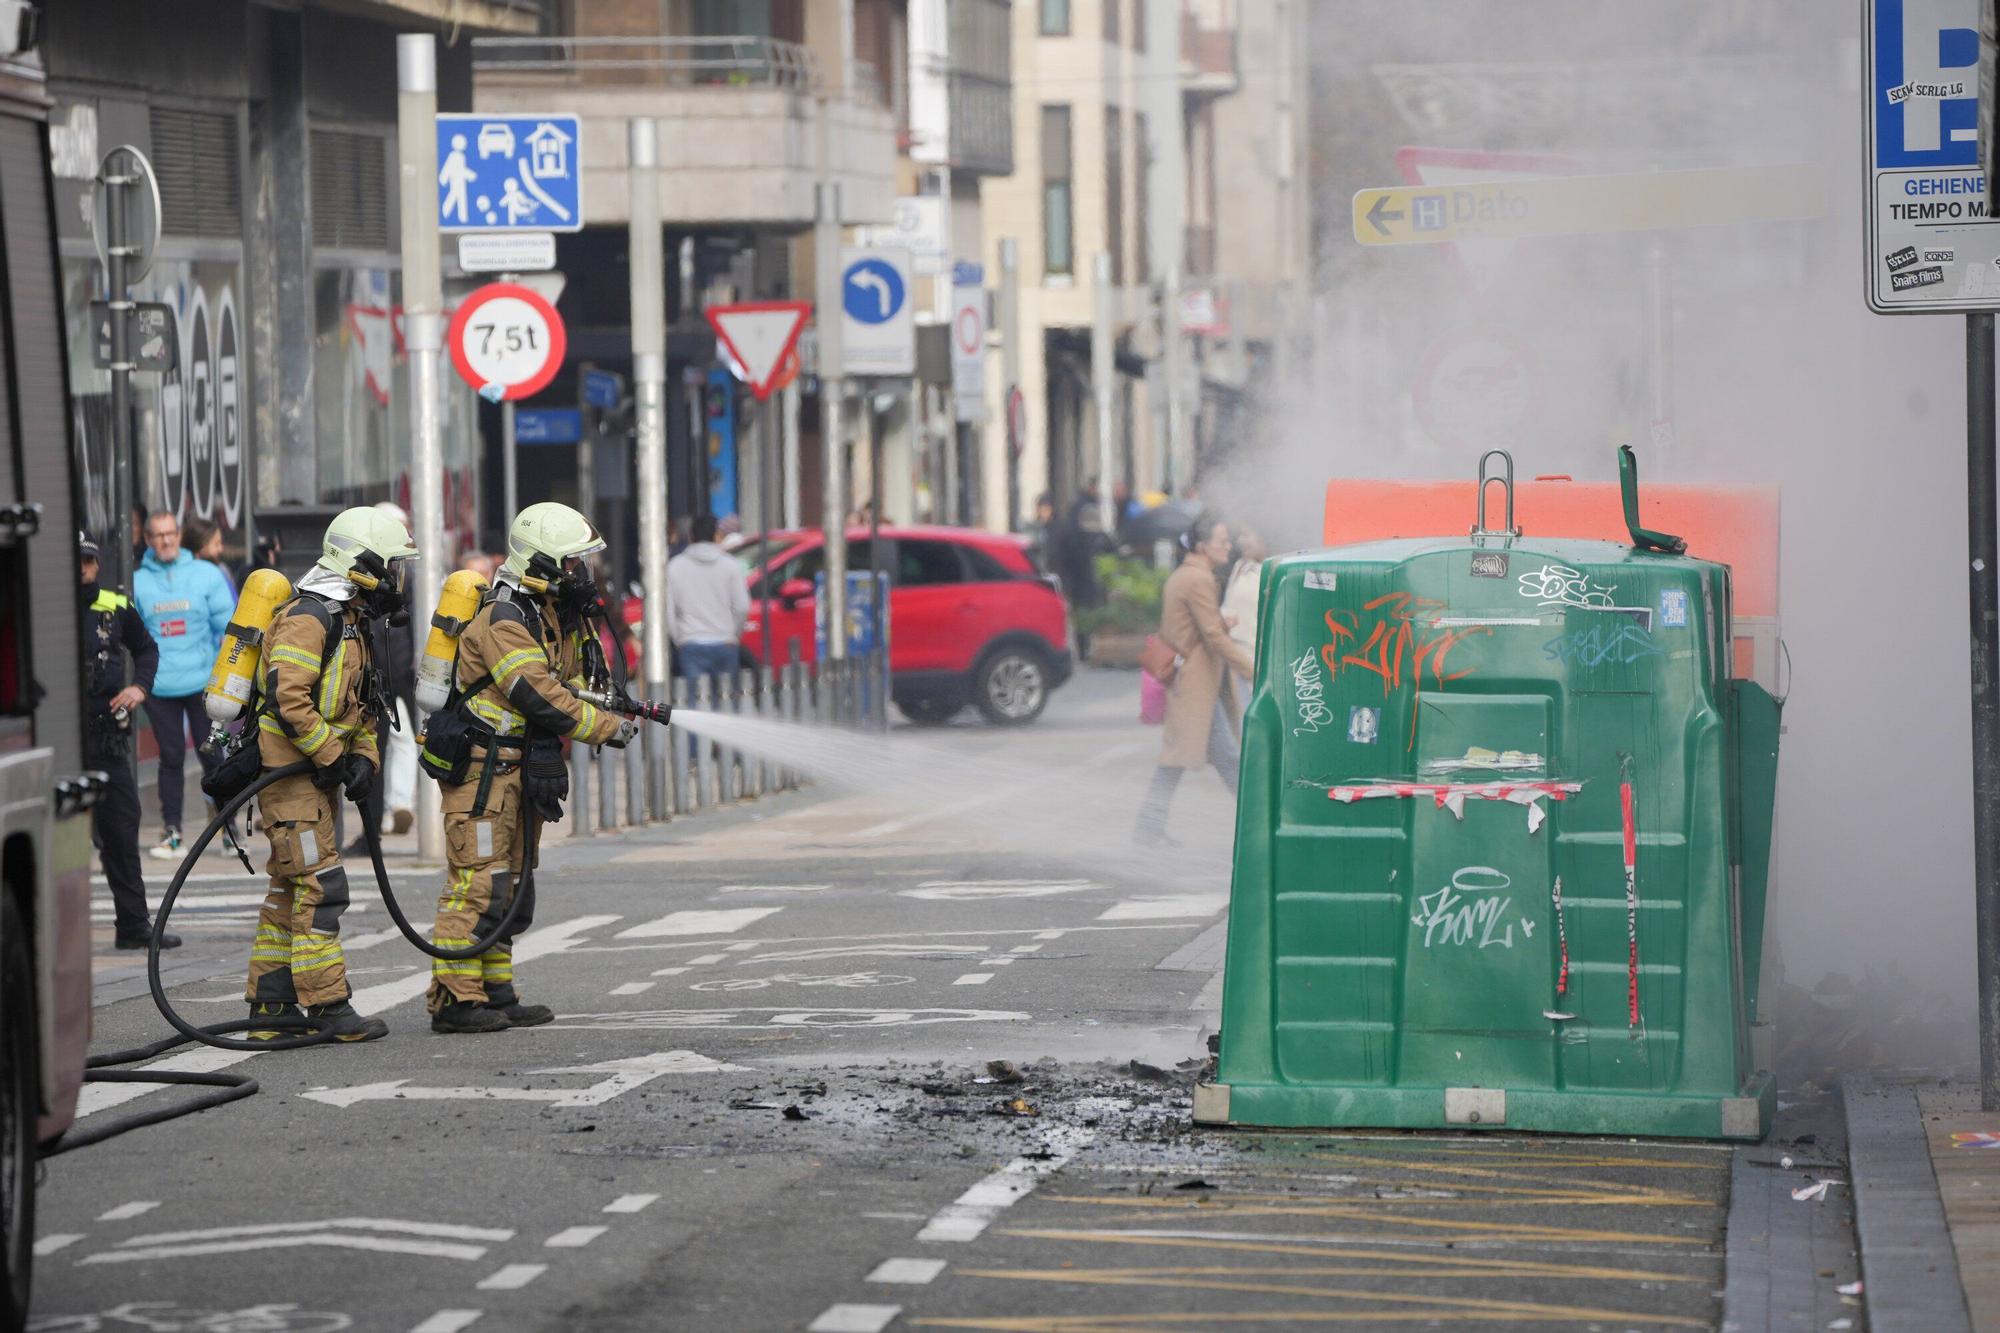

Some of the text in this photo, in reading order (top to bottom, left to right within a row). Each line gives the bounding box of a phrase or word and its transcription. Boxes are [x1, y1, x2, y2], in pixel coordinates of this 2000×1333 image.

[1904, 177, 1985, 196] GEHIENE
[1453, 190, 1528, 223] Dato
[1890, 202, 1962, 220] TIEMPO
[1893, 270, 1941, 288] Snare films
[474, 324, 538, 362] 7,5t
